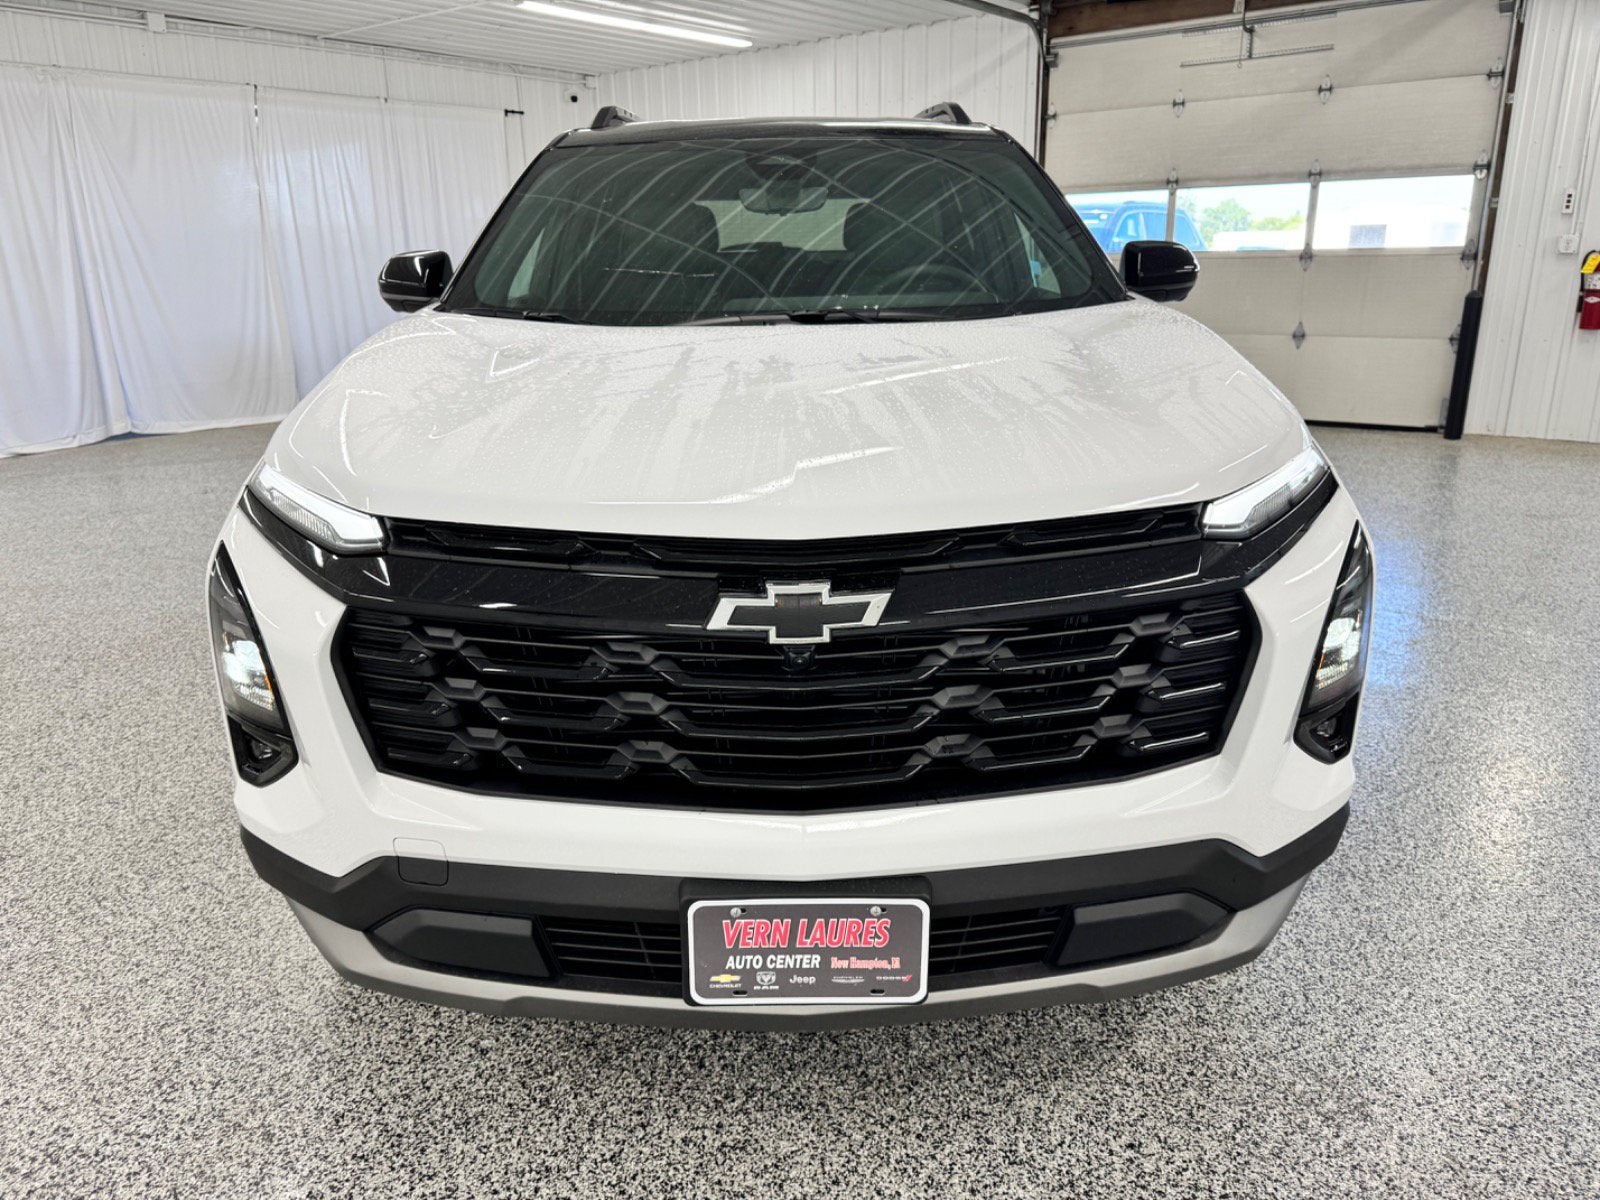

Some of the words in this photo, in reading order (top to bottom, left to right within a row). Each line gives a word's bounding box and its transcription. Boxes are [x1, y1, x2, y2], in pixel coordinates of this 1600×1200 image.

[722, 918, 790, 948] VERN
[796, 918, 891, 947] LAURES
[725, 955, 762, 970] AUTO
[766, 954, 821, 969] CENTER
[831, 956, 849, 969] New
[790, 974, 816, 985] Jeep
